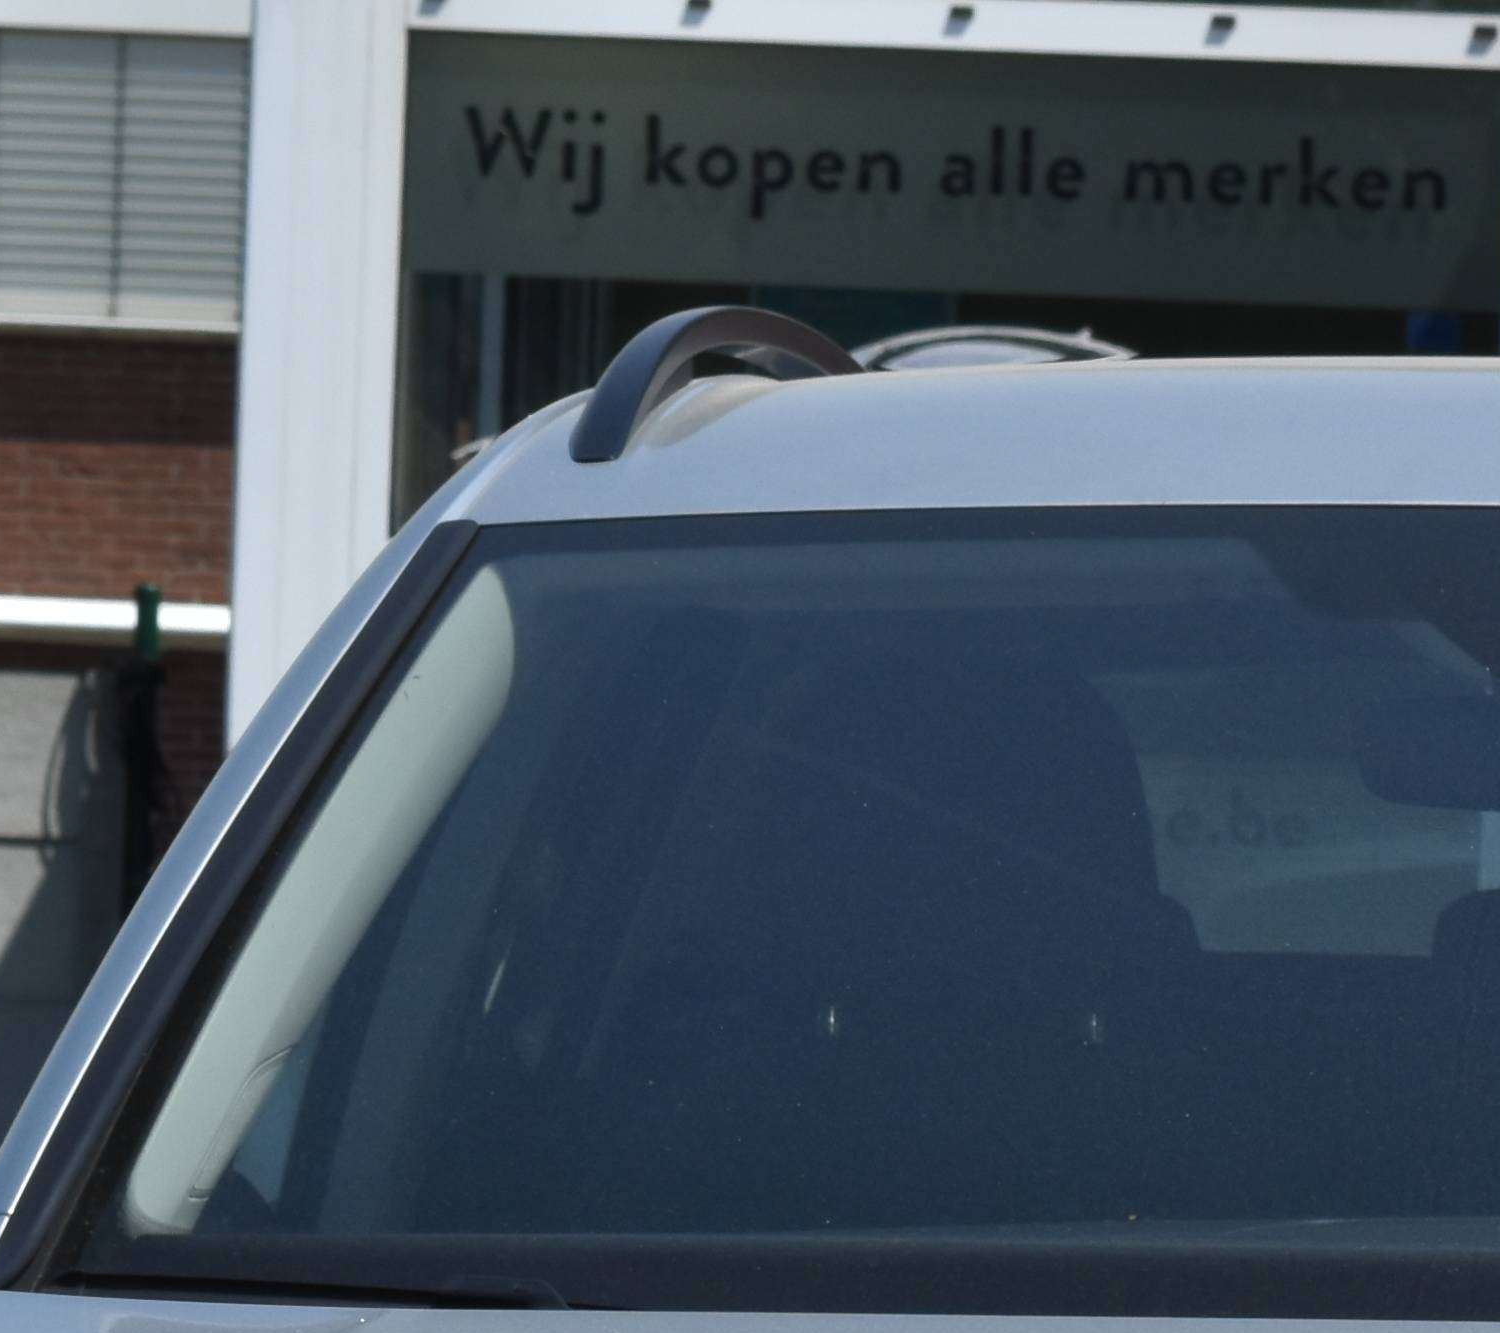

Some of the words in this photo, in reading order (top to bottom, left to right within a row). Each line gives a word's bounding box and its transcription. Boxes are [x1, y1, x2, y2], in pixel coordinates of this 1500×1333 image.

[463, 104, 606, 214] Wij
[644, 113, 901, 220] kopen
[940, 125, 1087, 202] alle
[1125, 139, 1447, 212] merken
